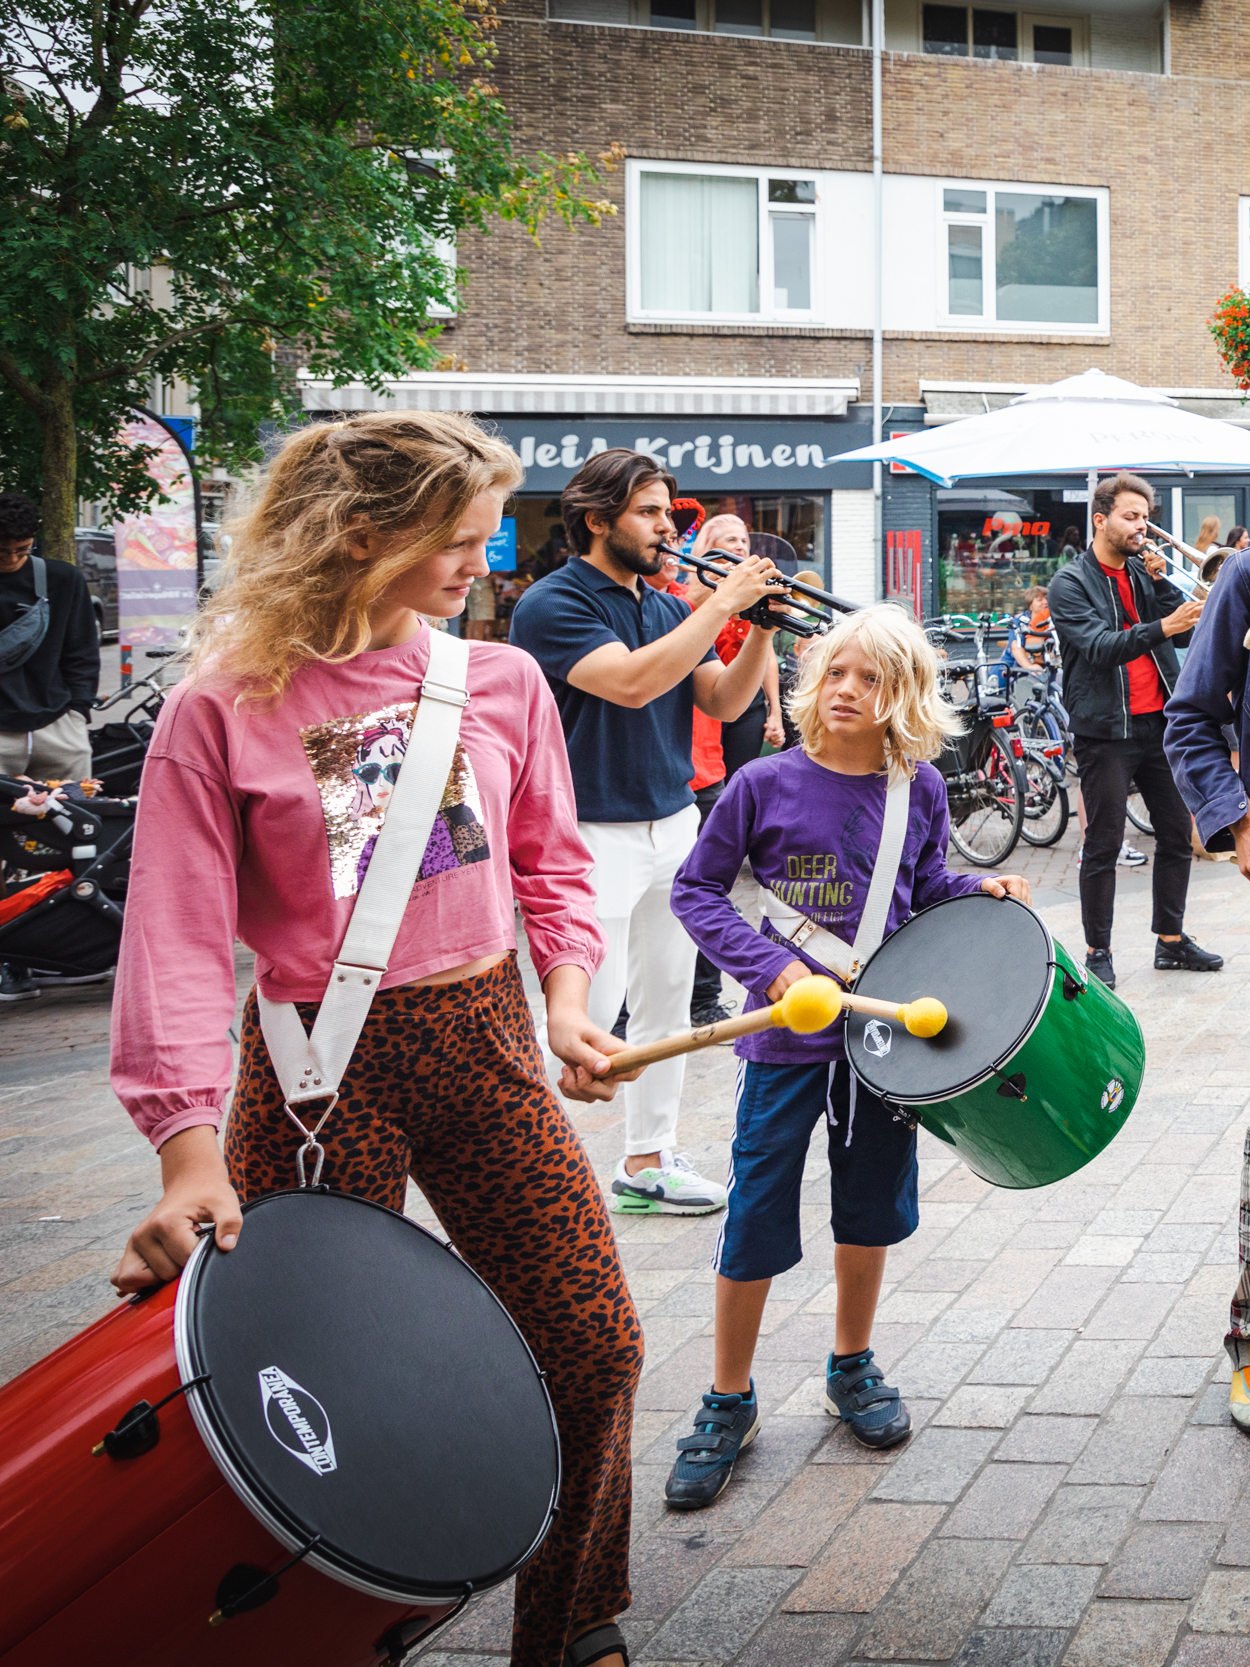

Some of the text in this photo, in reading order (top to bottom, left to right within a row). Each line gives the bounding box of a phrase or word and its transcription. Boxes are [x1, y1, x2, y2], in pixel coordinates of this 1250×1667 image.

[1088, 430, 1203, 444] PERONI
[634, 434, 826, 475] Krijnen
[981, 518, 1051, 537] Pino
[787, 854, 837, 879] DEER
[411, 871, 459, 893] ADVENTURE
[770, 879, 853, 907] HUNTING
